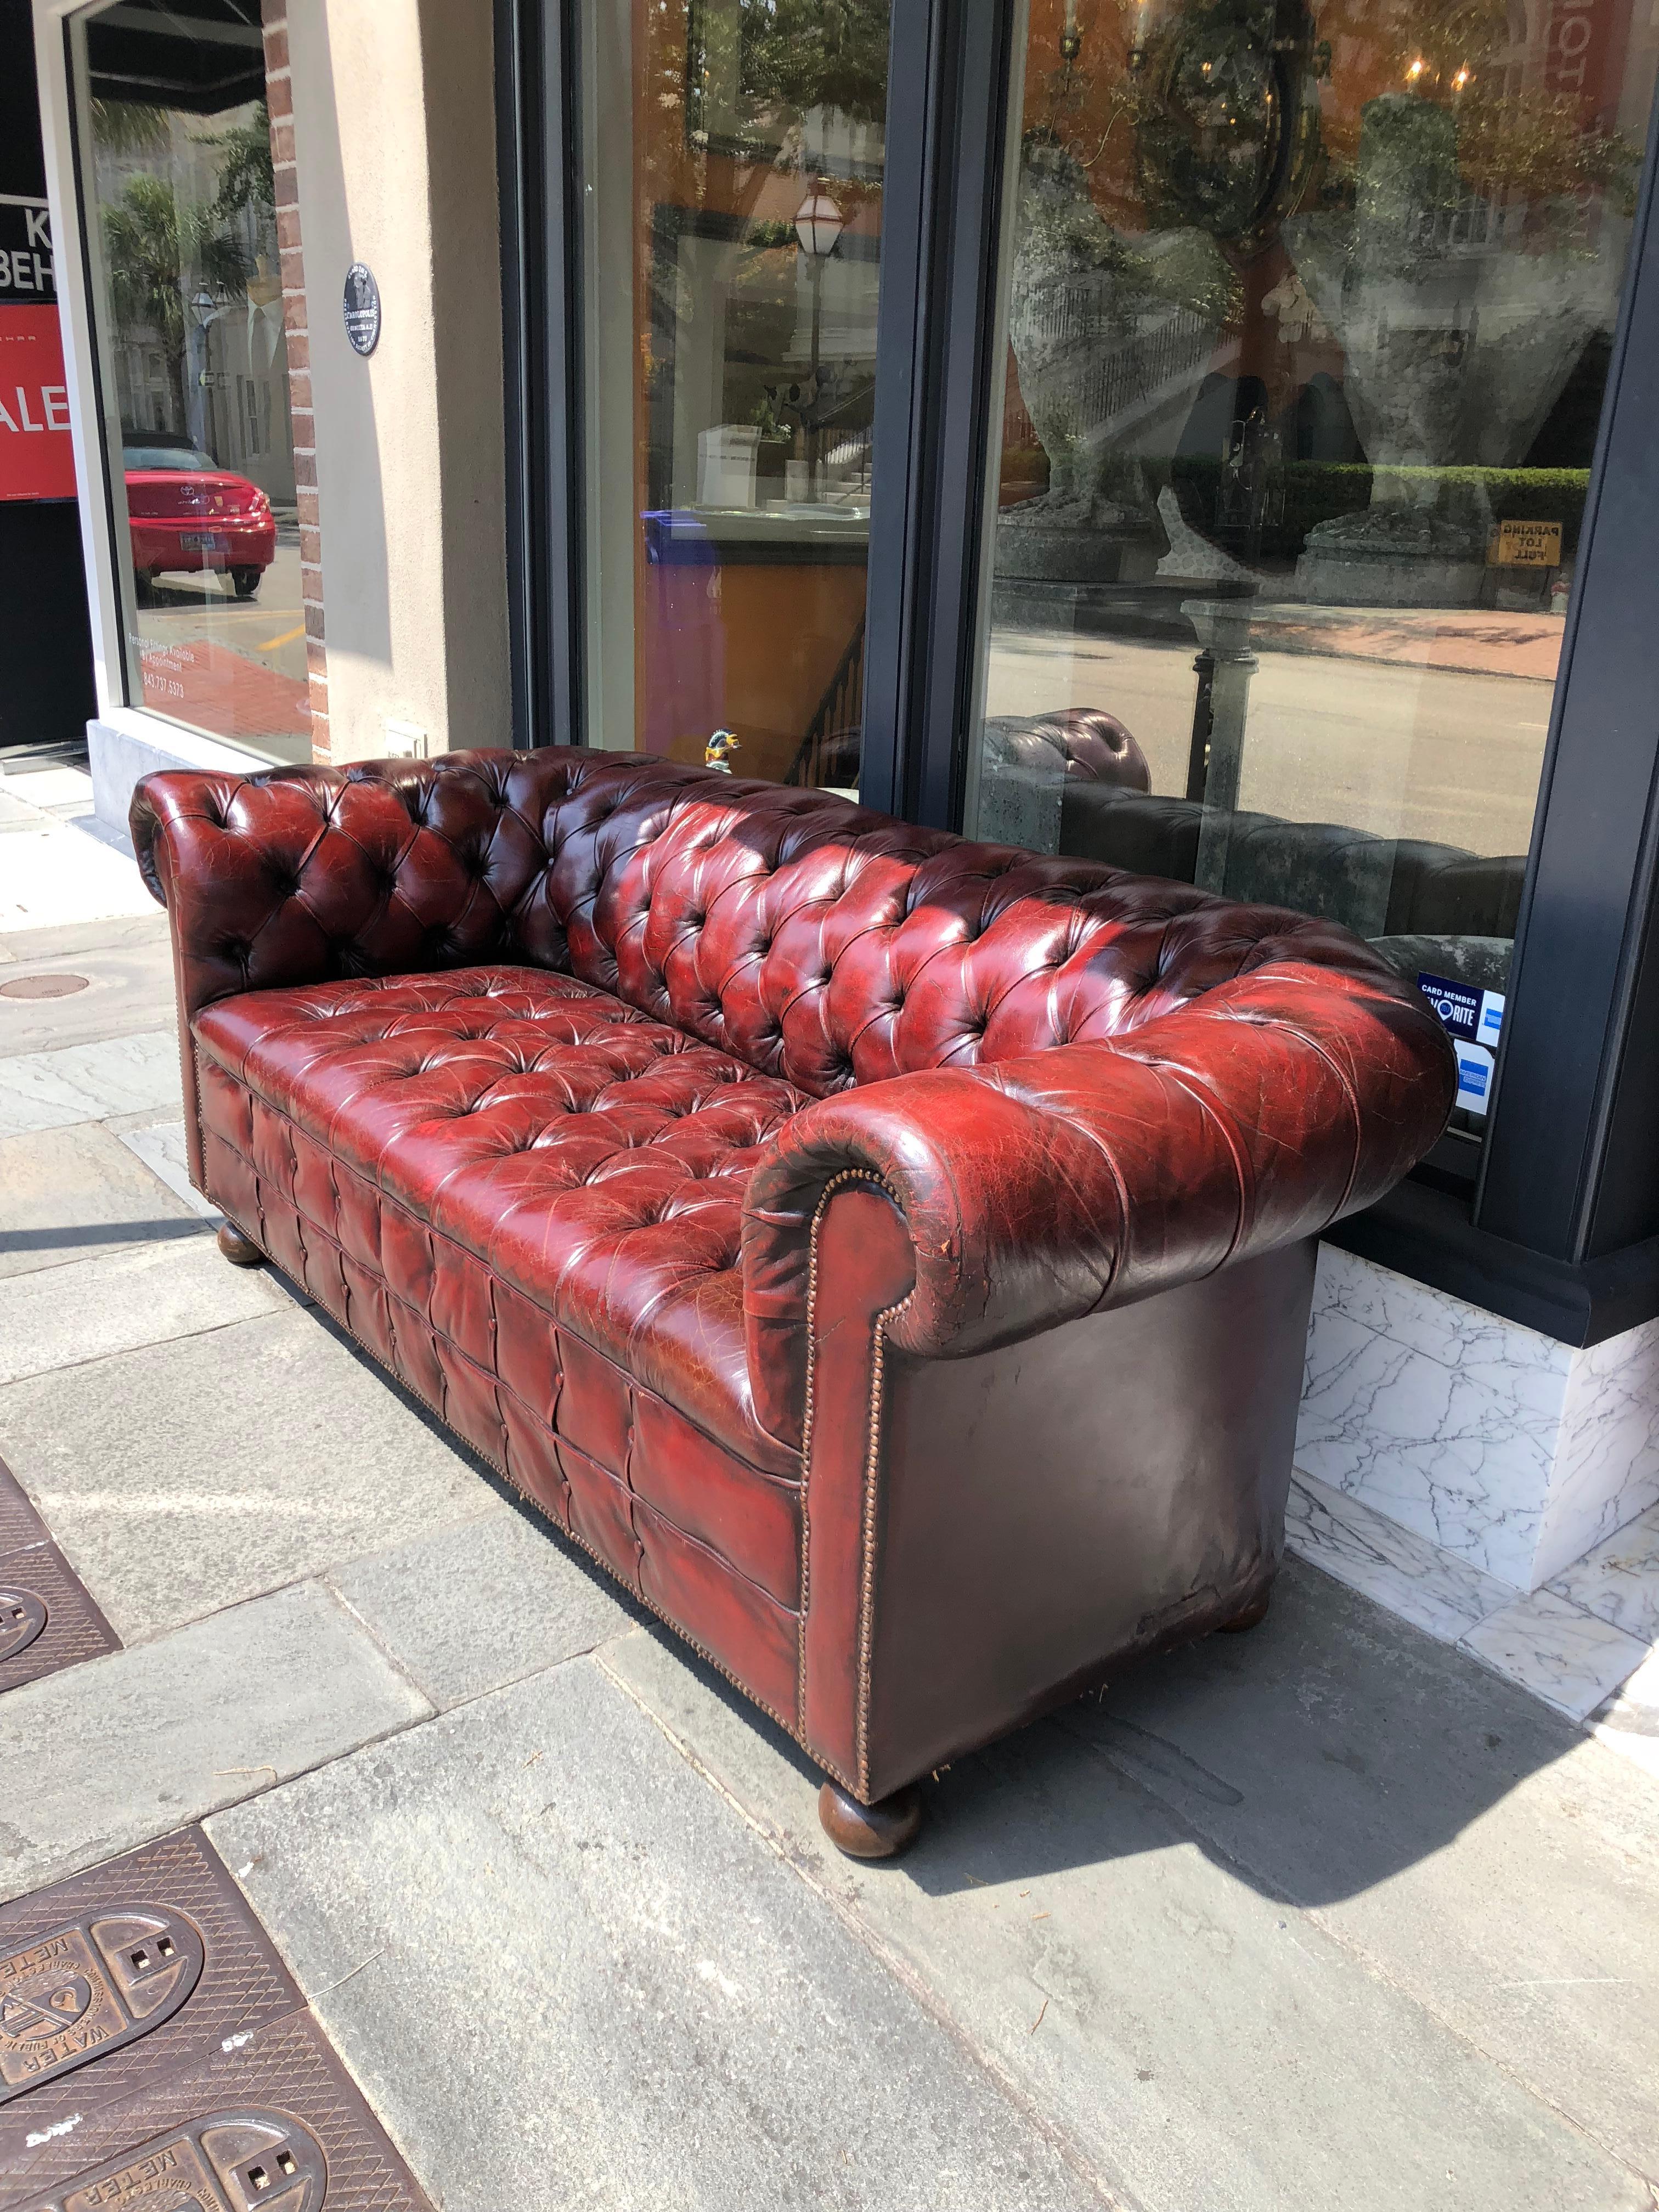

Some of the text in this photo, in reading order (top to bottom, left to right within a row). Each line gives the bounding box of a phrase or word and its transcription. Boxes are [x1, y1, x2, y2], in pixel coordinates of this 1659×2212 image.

[128, 633, 194, 663] Personal Fittings Available
[142, 650, 182, 673] By Appointment
[144, 672, 184, 698] 843.737.5373
[1421, 984, 1477, 1007] CARD MEMBER
[23, 2025, 110, 2073] WATER
[83, 2149, 177, 2205] METER
